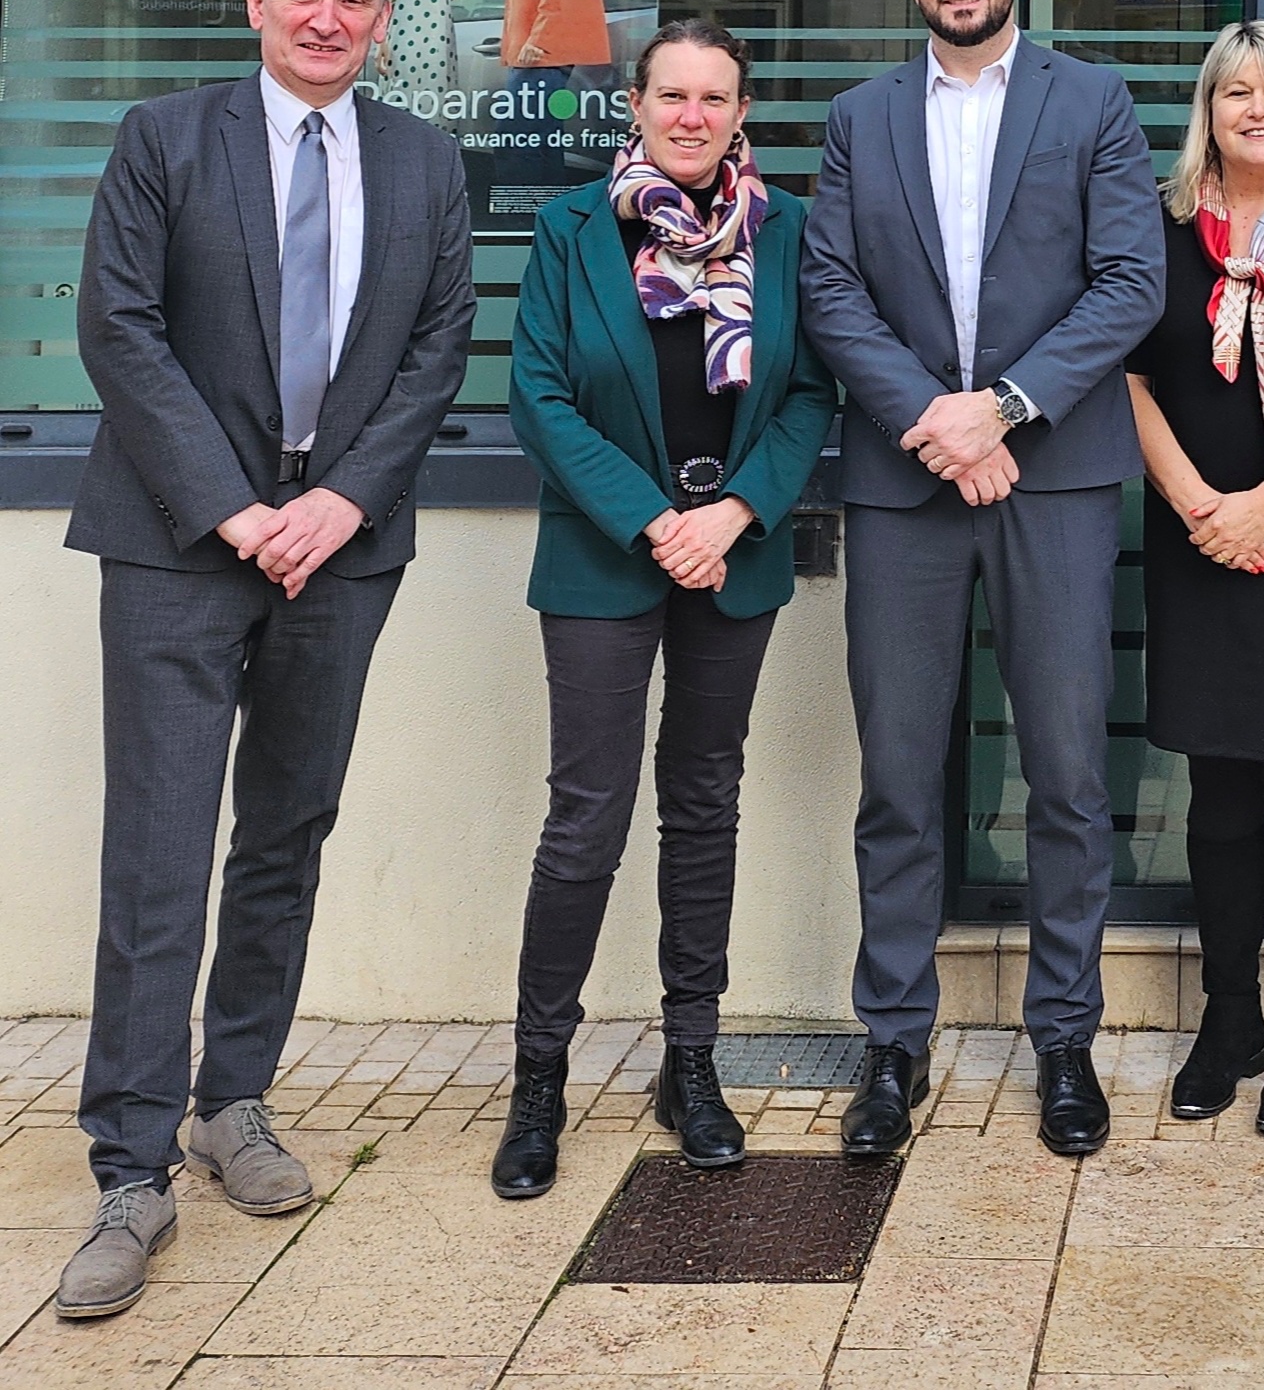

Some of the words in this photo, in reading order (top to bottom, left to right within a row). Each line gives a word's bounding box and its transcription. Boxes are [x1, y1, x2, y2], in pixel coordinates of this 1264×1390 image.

[462, 131, 541, 148] avance
[546, 129, 575, 148] de
[580, 128, 628, 148] frais
